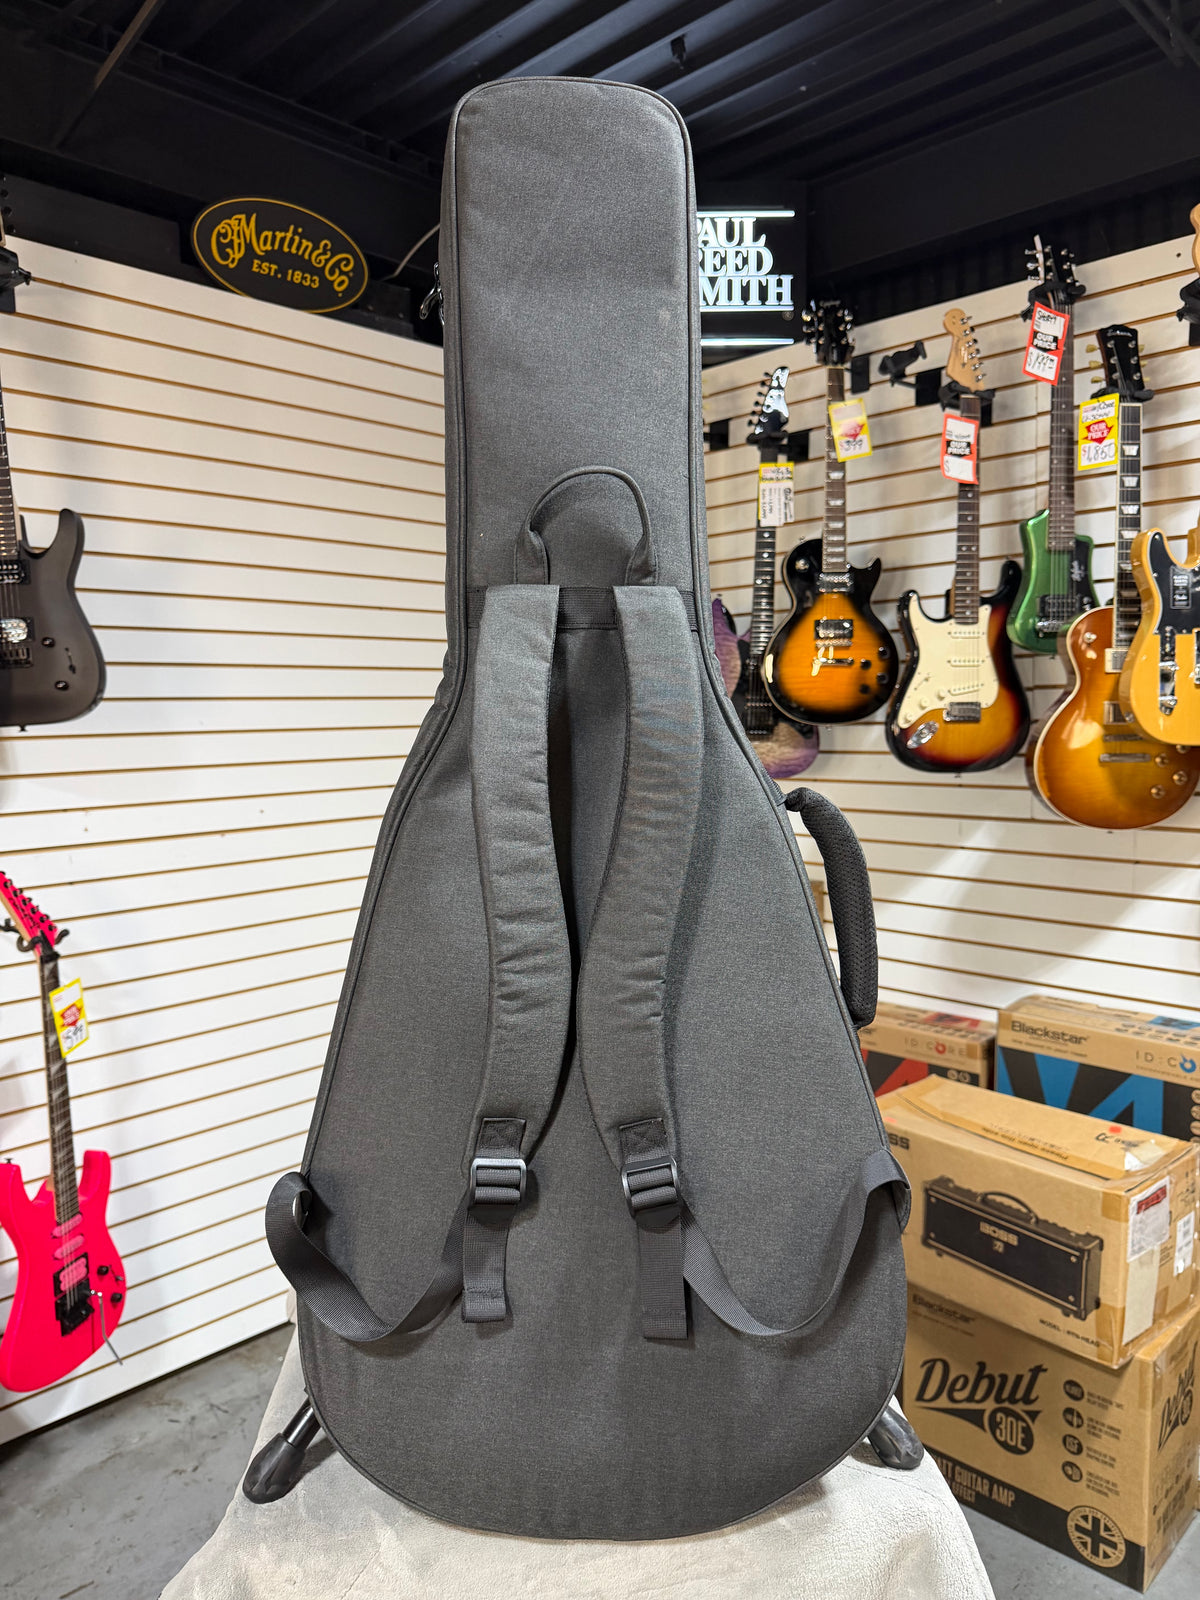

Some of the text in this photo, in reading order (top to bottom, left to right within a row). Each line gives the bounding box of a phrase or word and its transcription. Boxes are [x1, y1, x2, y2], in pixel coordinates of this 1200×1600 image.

[251, 259, 320, 289] EST. 1833
[700, 274, 794, 305] MITH
[1033, 338, 1057, 350] PRICE
[1036, 332, 1054, 343] OUR
[1087, 428, 1109, 440] PRICE
[1089, 421, 1107, 432] OUR
[947, 447, 971, 456] PRICE
[949, 440, 968, 449] OUR
[1011, 1020, 1088, 1046] Blackstar
[888, 1132, 910, 1150] SS
[980, 1221, 1019, 1247] BOSS
[915, 1358, 1048, 1406] Debut
[995, 1413, 1028, 1452] 30E
[954, 1465, 990, 1497] GUITAR
[991, 1483, 1016, 1508] AMP
